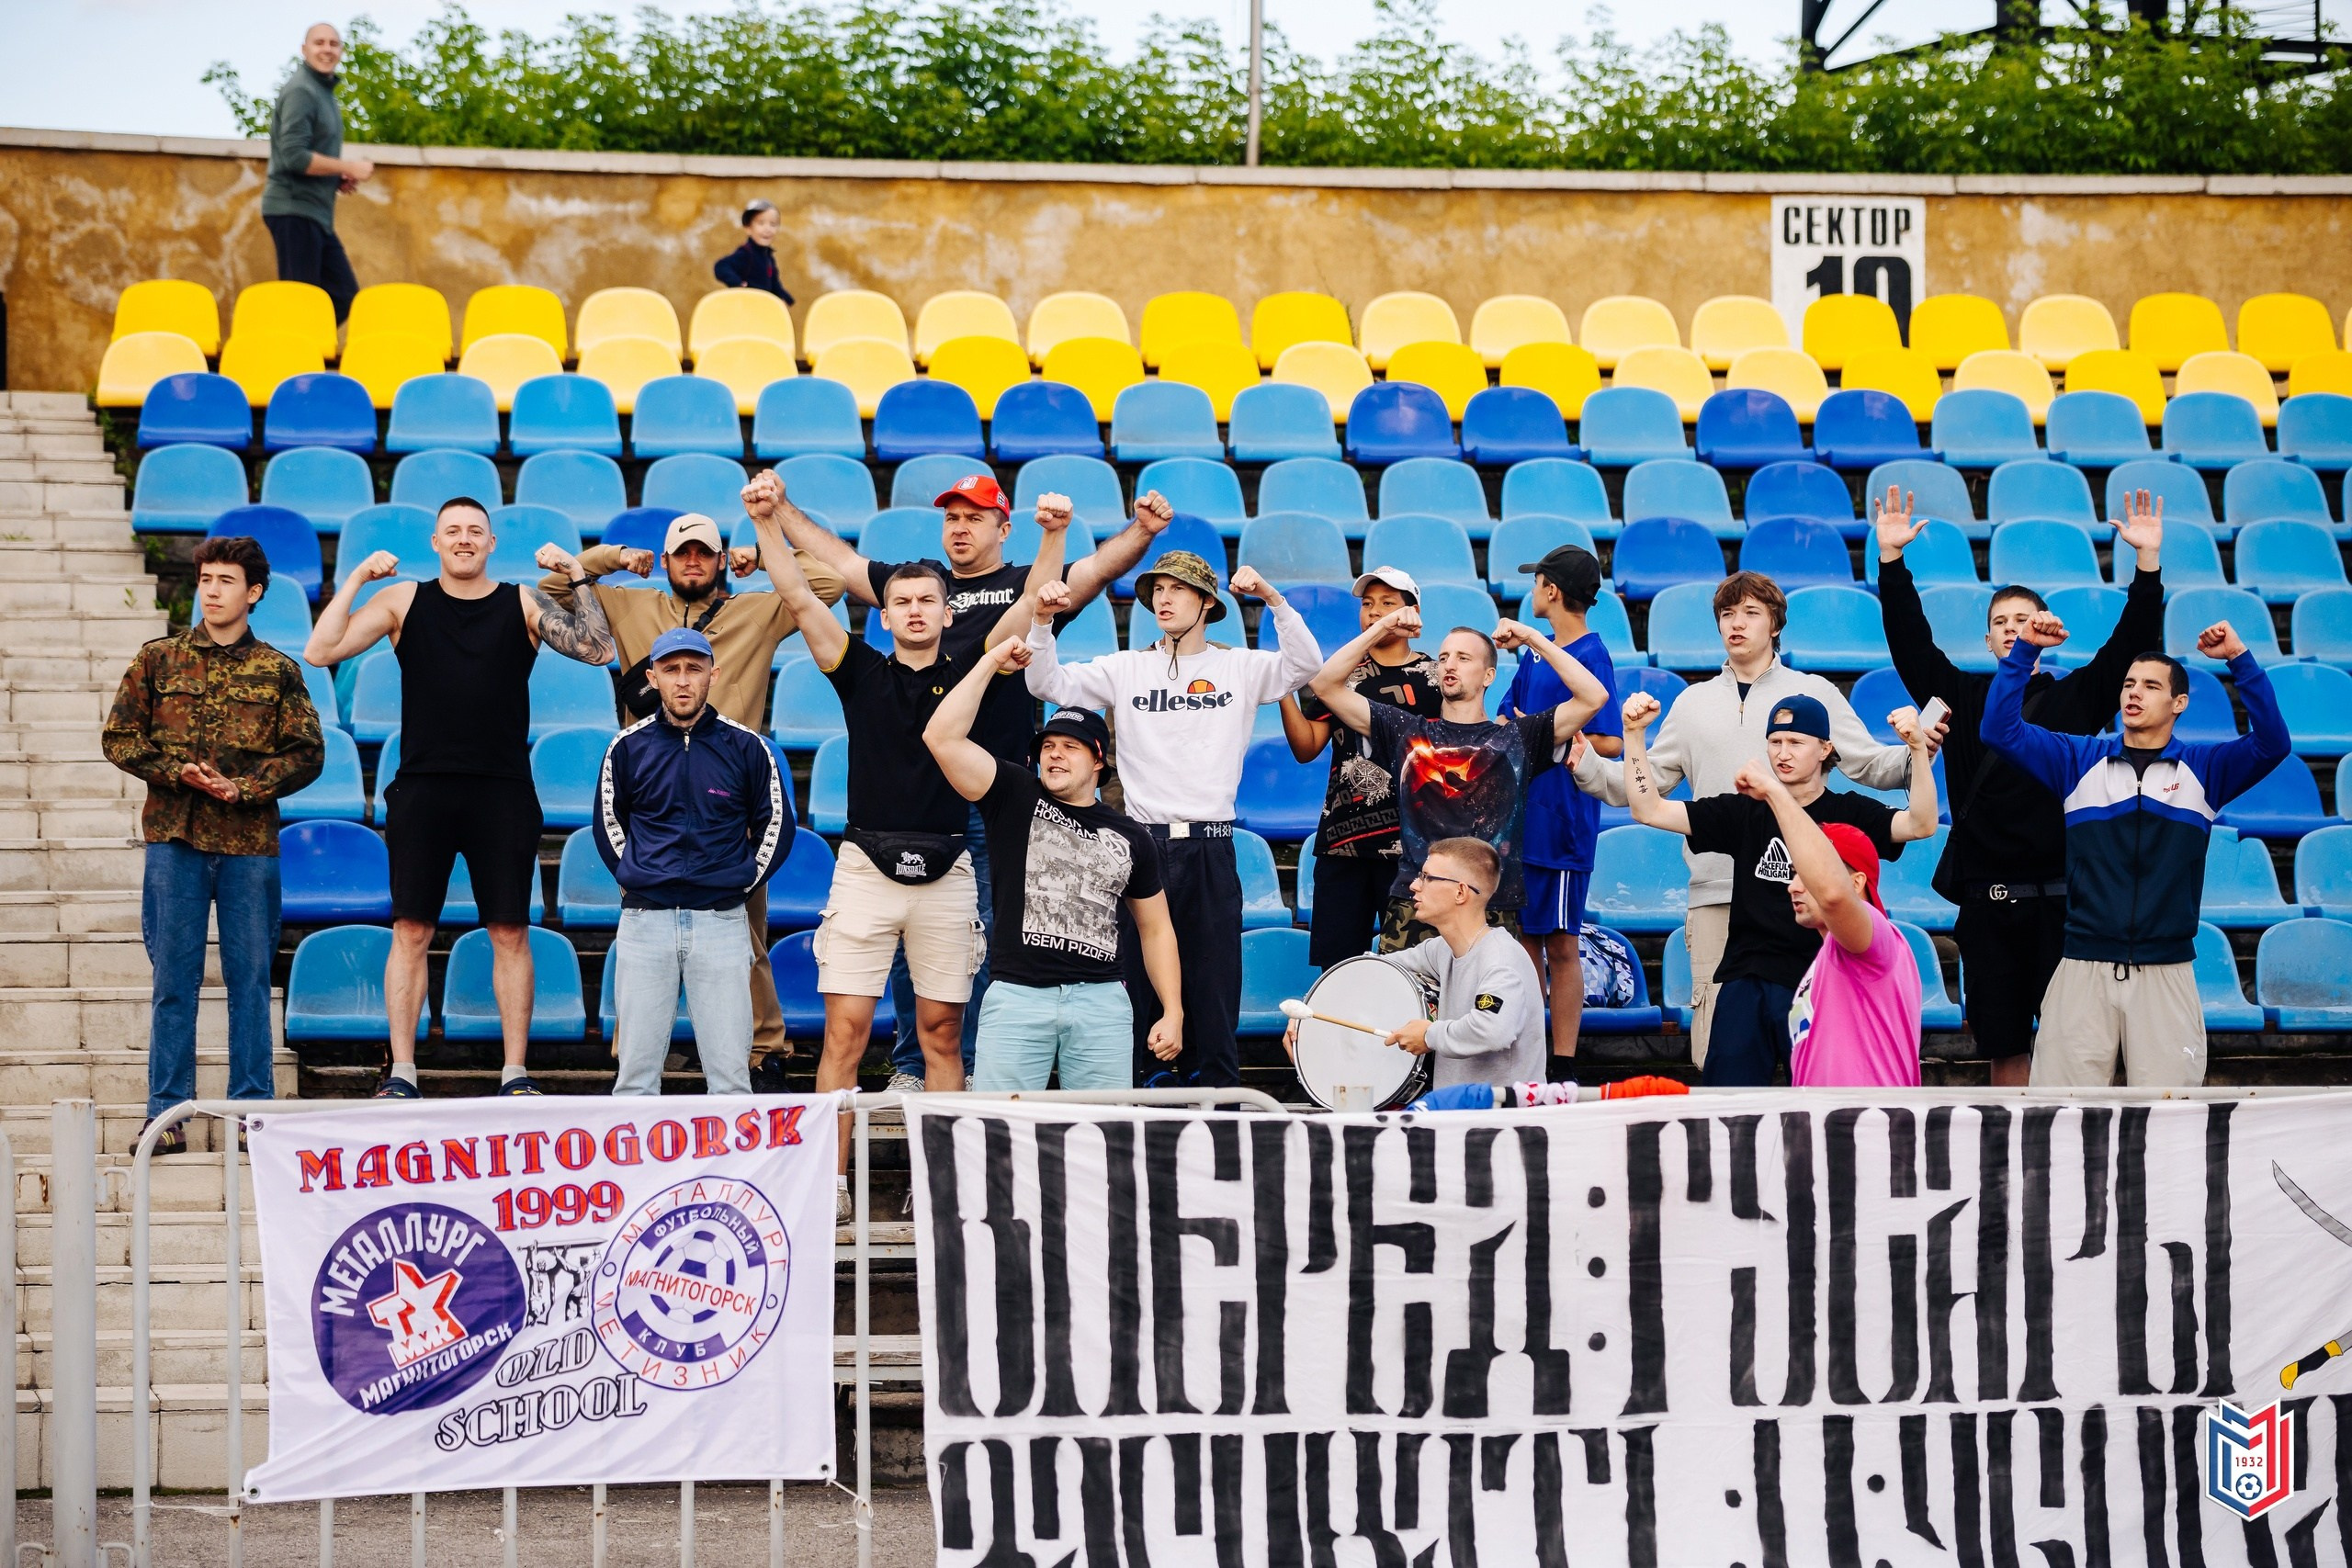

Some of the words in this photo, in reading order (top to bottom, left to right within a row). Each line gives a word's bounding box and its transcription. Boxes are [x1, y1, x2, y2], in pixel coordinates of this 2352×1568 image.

[1783, 206, 1911, 246] СЕКТОР
[1131, 689, 1234, 712] ellesse
[1034, 806, 1100, 841] HOOLANS
[1036, 797, 1082, 828] RUSSAN
[1022, 932, 1066, 951] VSEM
[295, 1105, 807, 1193] MAGNITOGORSK
[492, 1180, 625, 1232] 1999
[622, 1181, 787, 1271] МЕТАЛЛУРГ
[653, 1206, 760, 1256] ФУТБОЛЬНЫЙ
[319, 1212, 487, 1317] МЕТАЛЛУРГ
[624, 1269, 757, 1316] МАГНИТОГОРСК
[494, 1326, 597, 1389] OLD
[595, 1291, 767, 1387] МЕТИЗНИК
[638, 1328, 707, 1358] КЛУБ
[358, 1322, 514, 1409] МАГНИТОГОРСК
[434, 1371, 649, 1452] SCHOOL
